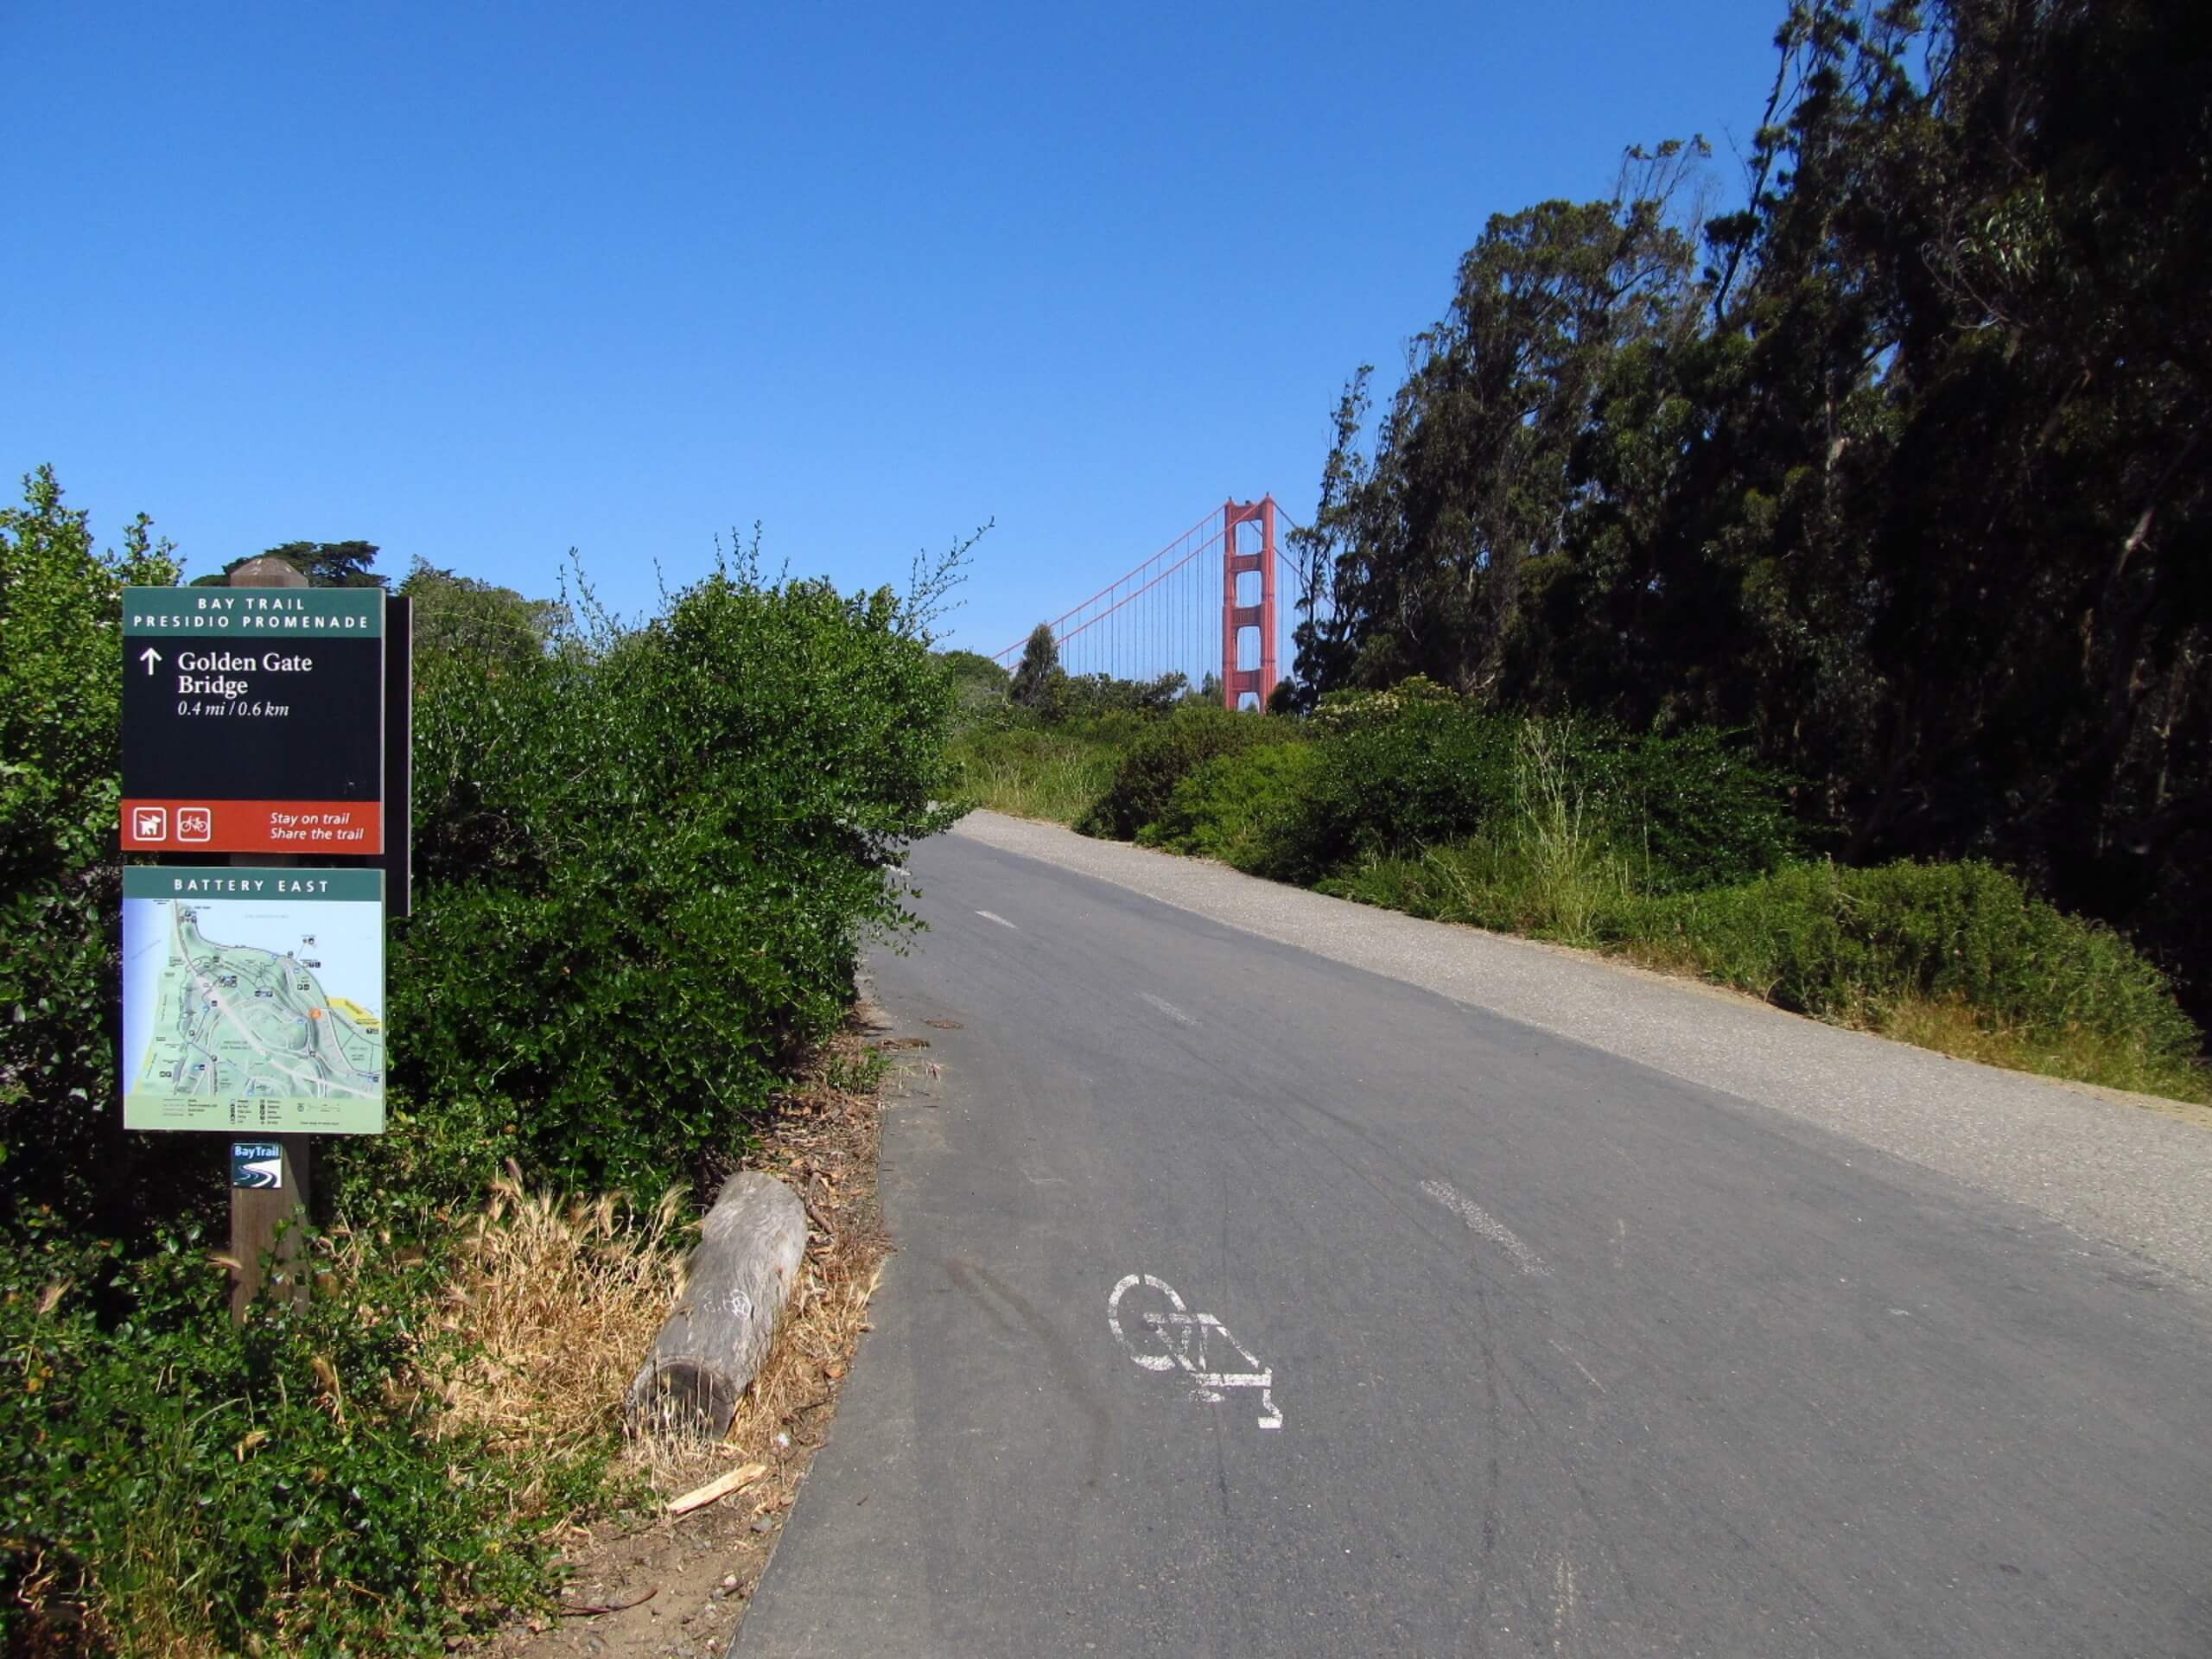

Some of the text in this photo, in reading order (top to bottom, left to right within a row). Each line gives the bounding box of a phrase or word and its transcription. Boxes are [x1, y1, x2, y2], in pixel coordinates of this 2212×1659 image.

[199, 599, 303, 610] BAY TRAIL
[134, 616, 366, 627] PRESIDIO PROMENADE
[178, 652, 312, 671] Golden Gate
[178, 677, 247, 698] Bridge
[178, 701, 289, 715] 0.4 mi / 0.6 km
[270, 812, 349, 826] Stay on trail
[270, 827, 364, 840] Share the trail
[175, 879, 327, 892] BATTERY EAST
